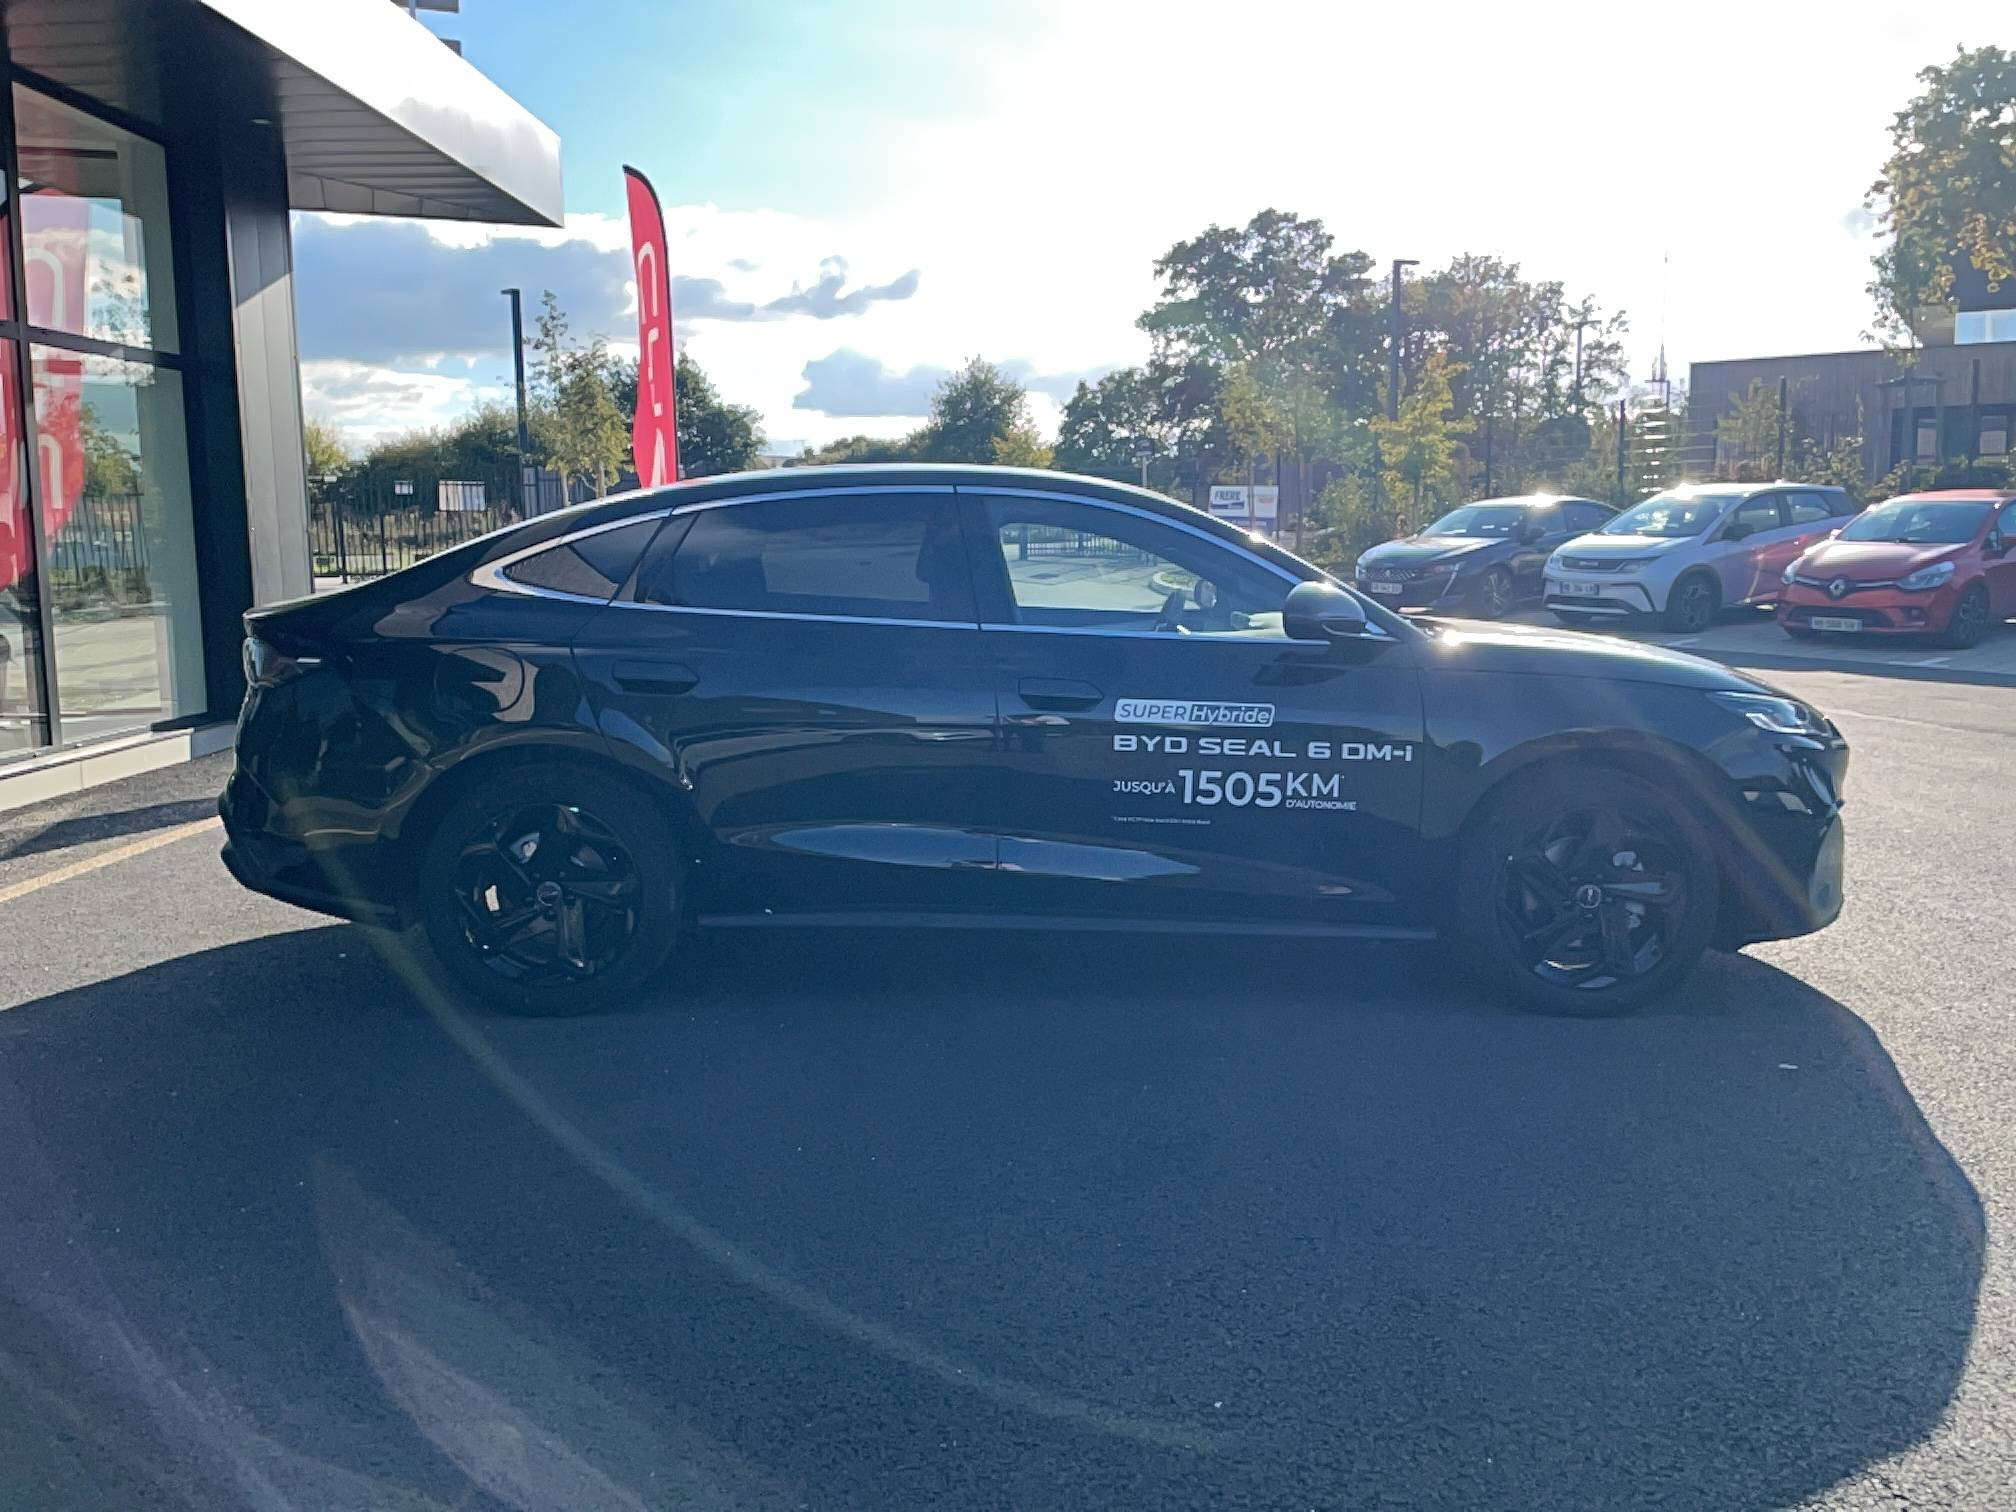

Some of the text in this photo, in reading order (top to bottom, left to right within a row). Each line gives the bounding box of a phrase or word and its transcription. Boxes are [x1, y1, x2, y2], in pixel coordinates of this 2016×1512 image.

[1119, 703, 1271, 724] SUPER Hybride
[1113, 735, 1188, 753] BYD
[1198, 737, 1297, 758] SEAL
[1308, 742, 1332, 758] 6
[1178, 769, 1282, 807] 1505
